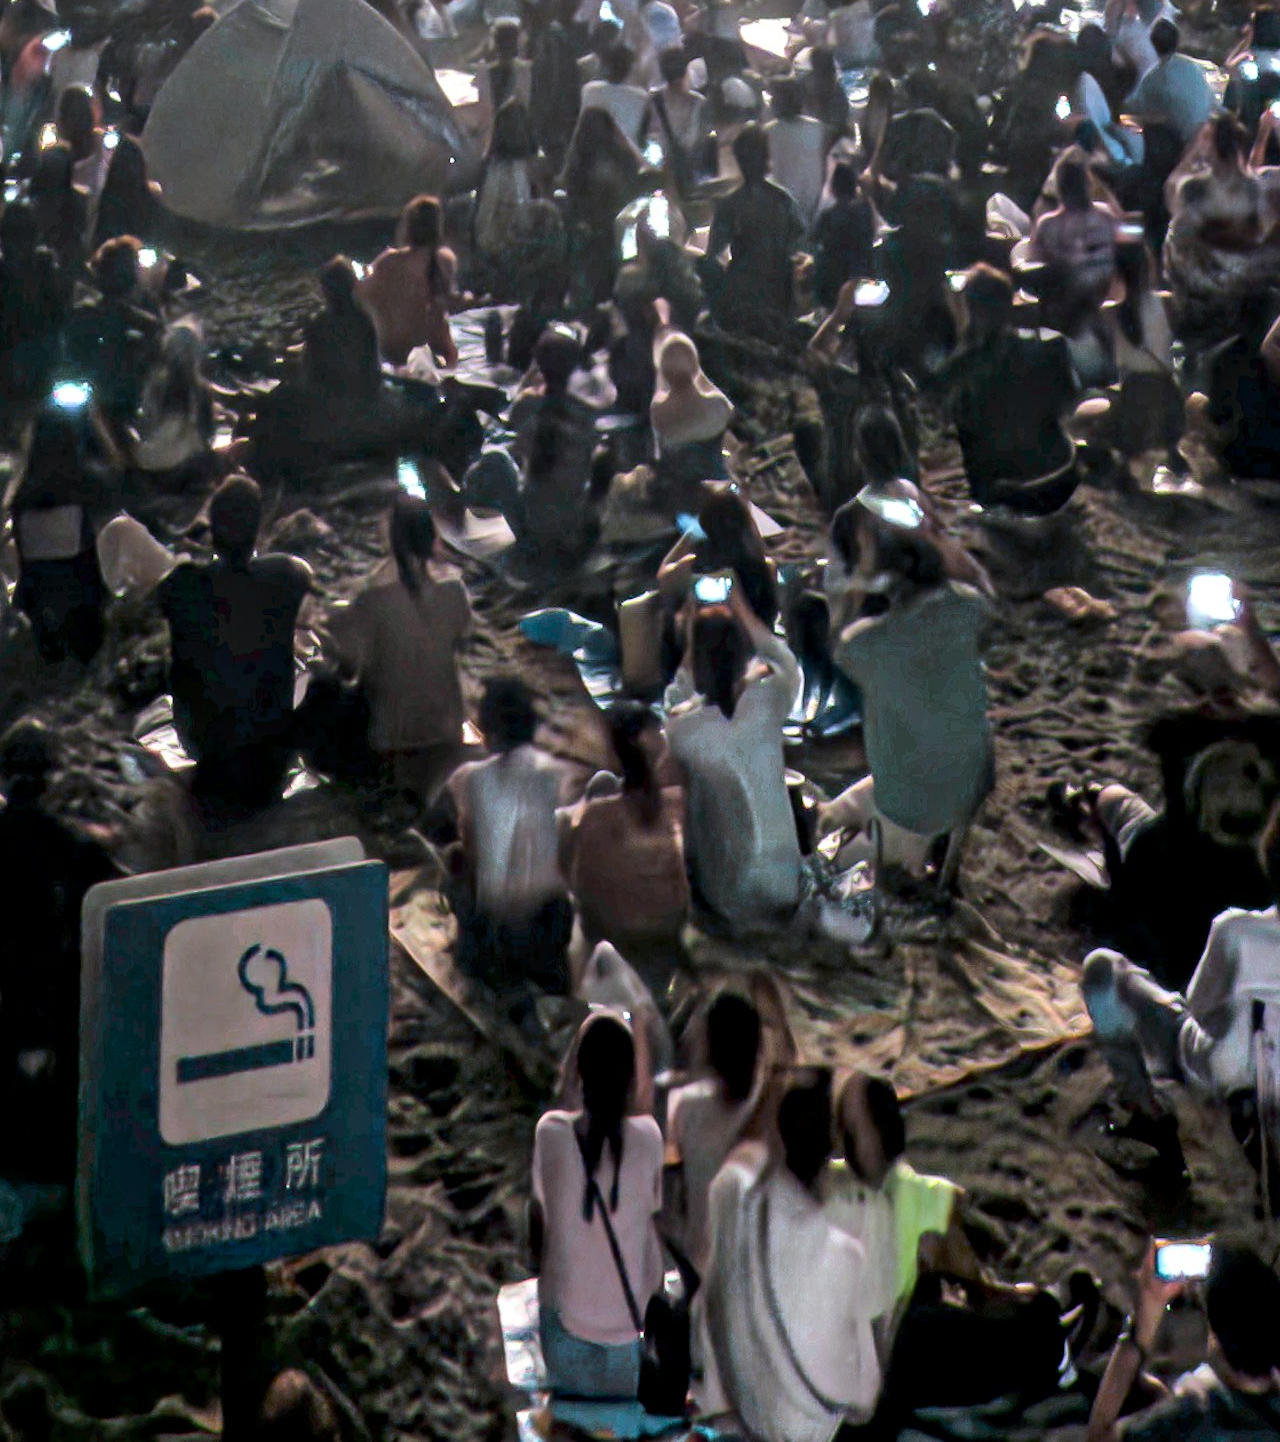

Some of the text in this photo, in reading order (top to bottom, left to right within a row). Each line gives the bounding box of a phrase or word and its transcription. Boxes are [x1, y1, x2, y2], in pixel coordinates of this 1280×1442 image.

[164, 1138, 325, 1215] 喫煙所
[265, 1200, 322, 1232] AREA
